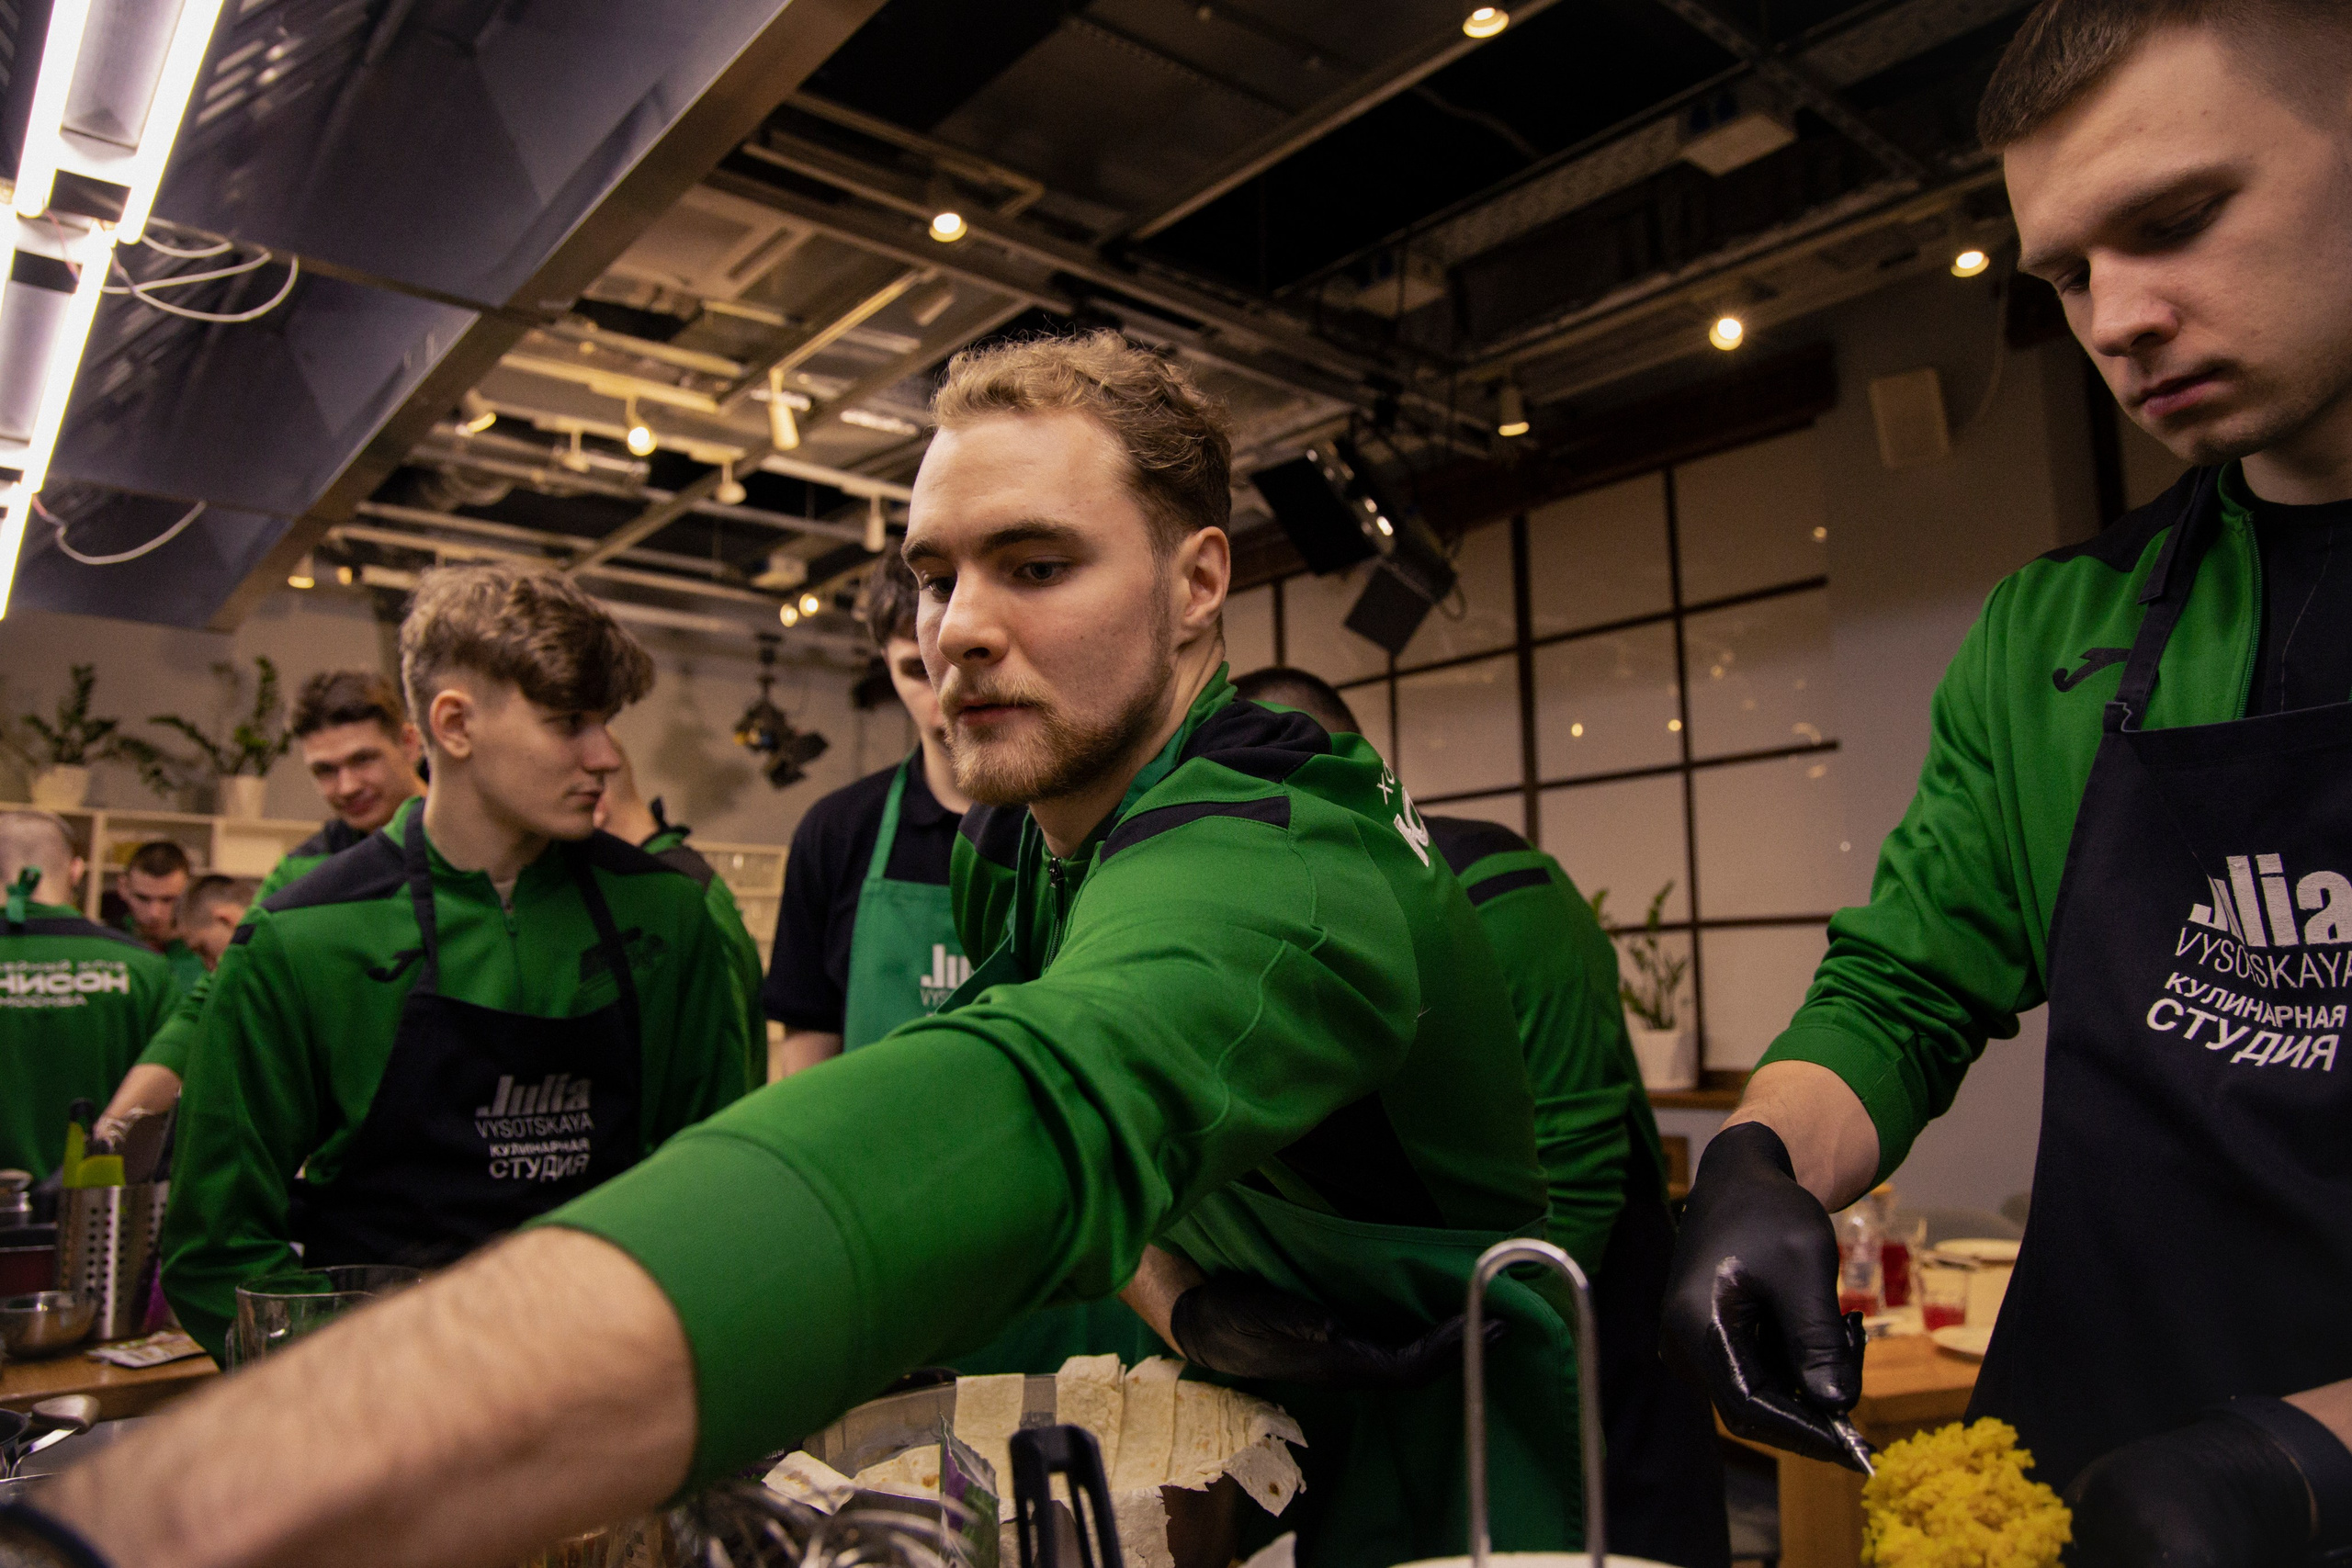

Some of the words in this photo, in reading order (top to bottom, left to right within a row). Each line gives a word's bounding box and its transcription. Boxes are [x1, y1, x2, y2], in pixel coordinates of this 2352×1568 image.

[2175, 927, 2352, 989] VYSOSKAY
[2164, 972, 2347, 1029] КУЛИНАРНАЯ
[2146, 998, 2340, 1072] СТУДИЯ
[475, 1072, 592, 1118] Julia
[474, 1111, 595, 1139] VYSOTSKAYA
[489, 1137, 591, 1158] КУЛИНАРНАЯ
[489, 1153, 591, 1183] СТУДИЯ
